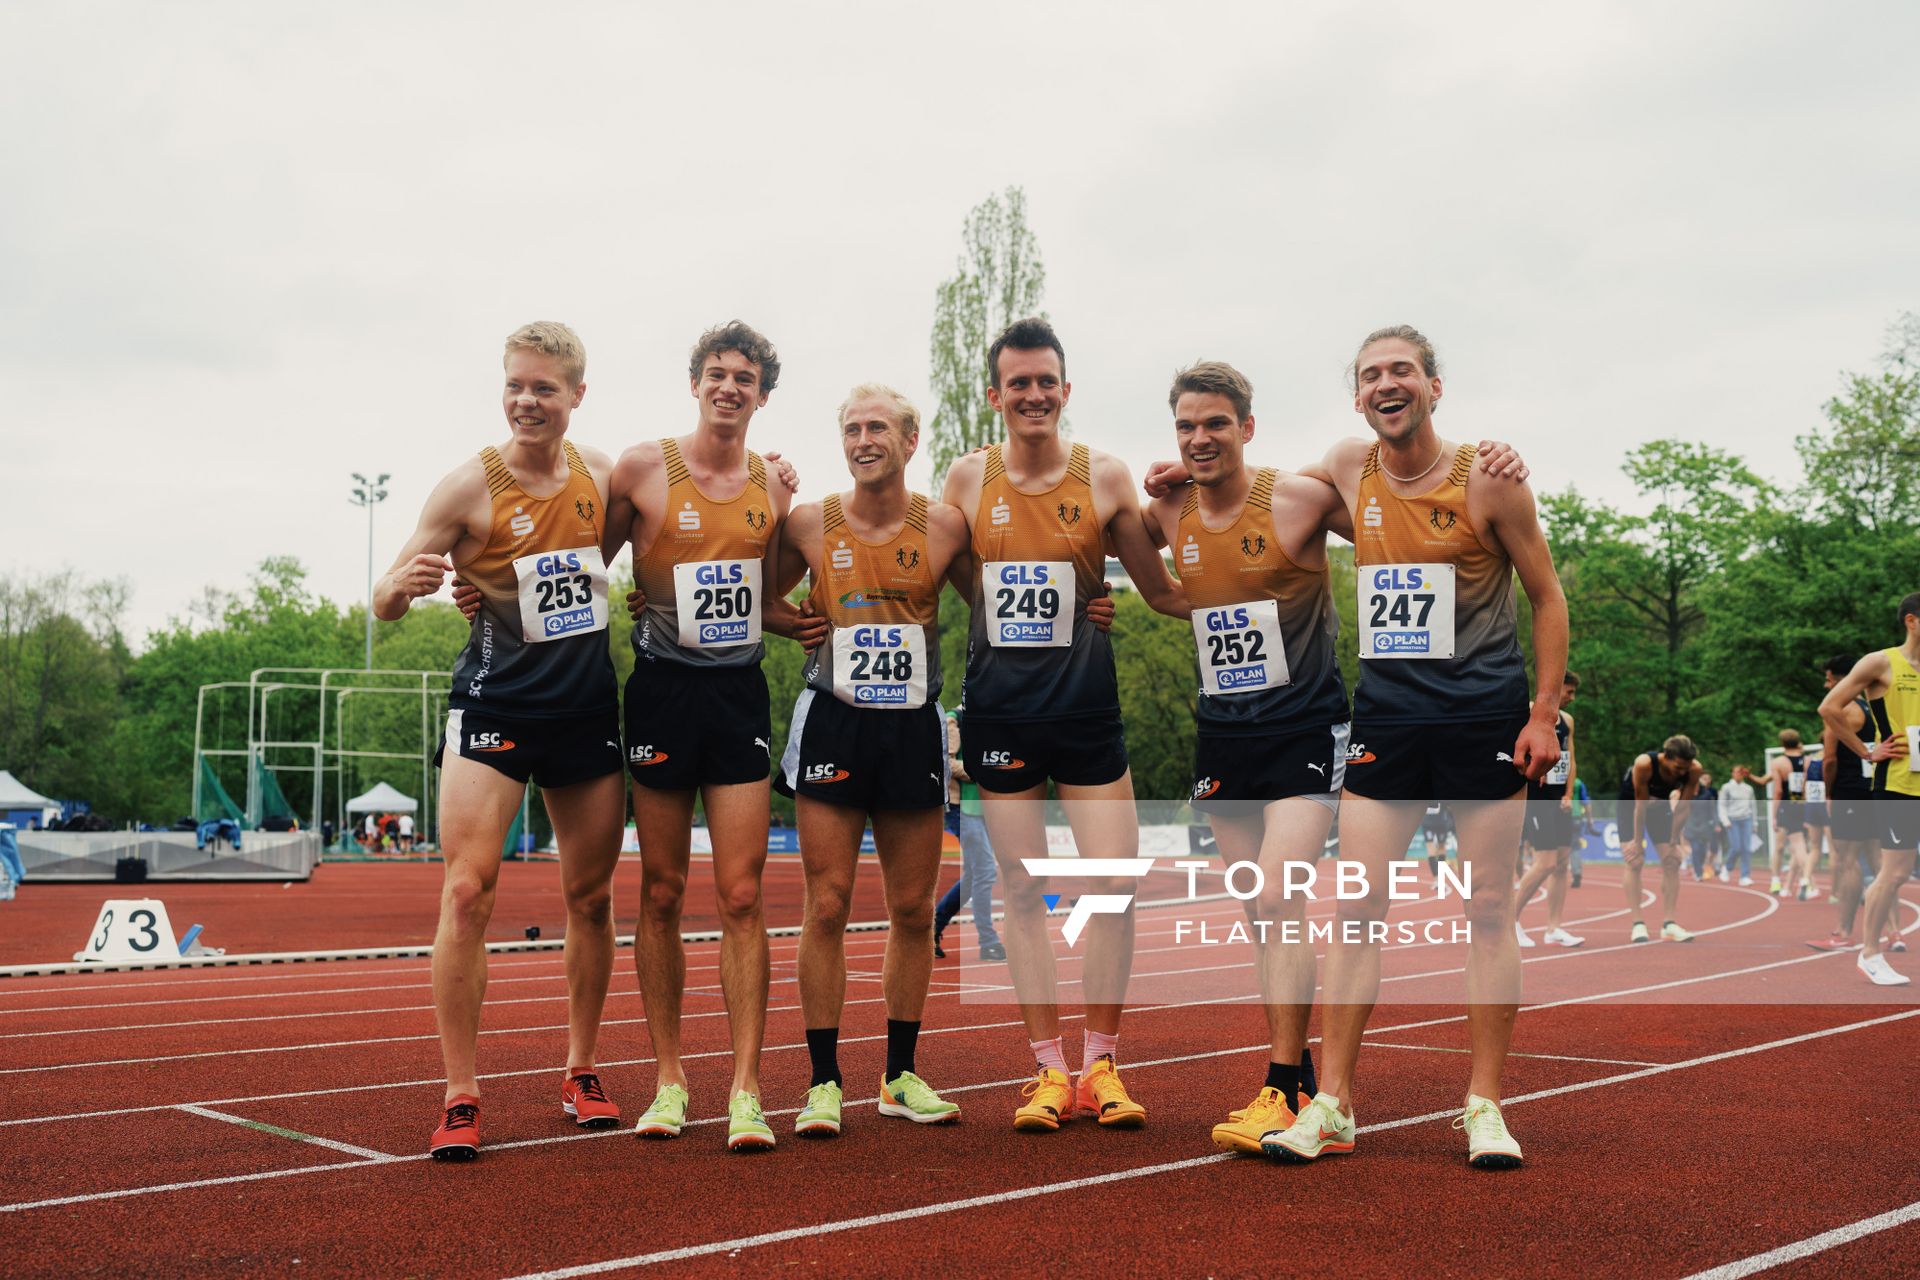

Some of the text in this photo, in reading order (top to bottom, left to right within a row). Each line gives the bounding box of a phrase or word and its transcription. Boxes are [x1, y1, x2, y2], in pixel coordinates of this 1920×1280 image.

[536, 574, 593, 613] 253
[694, 587, 752, 620] 250
[996, 588, 1059, 619] 249
[1370, 594, 1435, 627] 247
[565, 610, 592, 625] PLAN
[721, 624, 746, 635] PLAN
[1022, 625, 1050, 635] PLAN
[1394, 635, 1427, 645] PLAN
[1207, 630, 1267, 666] 252
[850, 650, 912, 681] 248
[1235, 668, 1263, 681] PLAN
[877, 688, 905, 697] PLAN
[470, 732, 500, 746] LSC
[631, 744, 653, 759] LSC
[982, 750, 1010, 763] LSC
[806, 763, 834, 778] LSC
[95, 909, 113, 952] 3
[128, 909, 159, 952] 3
